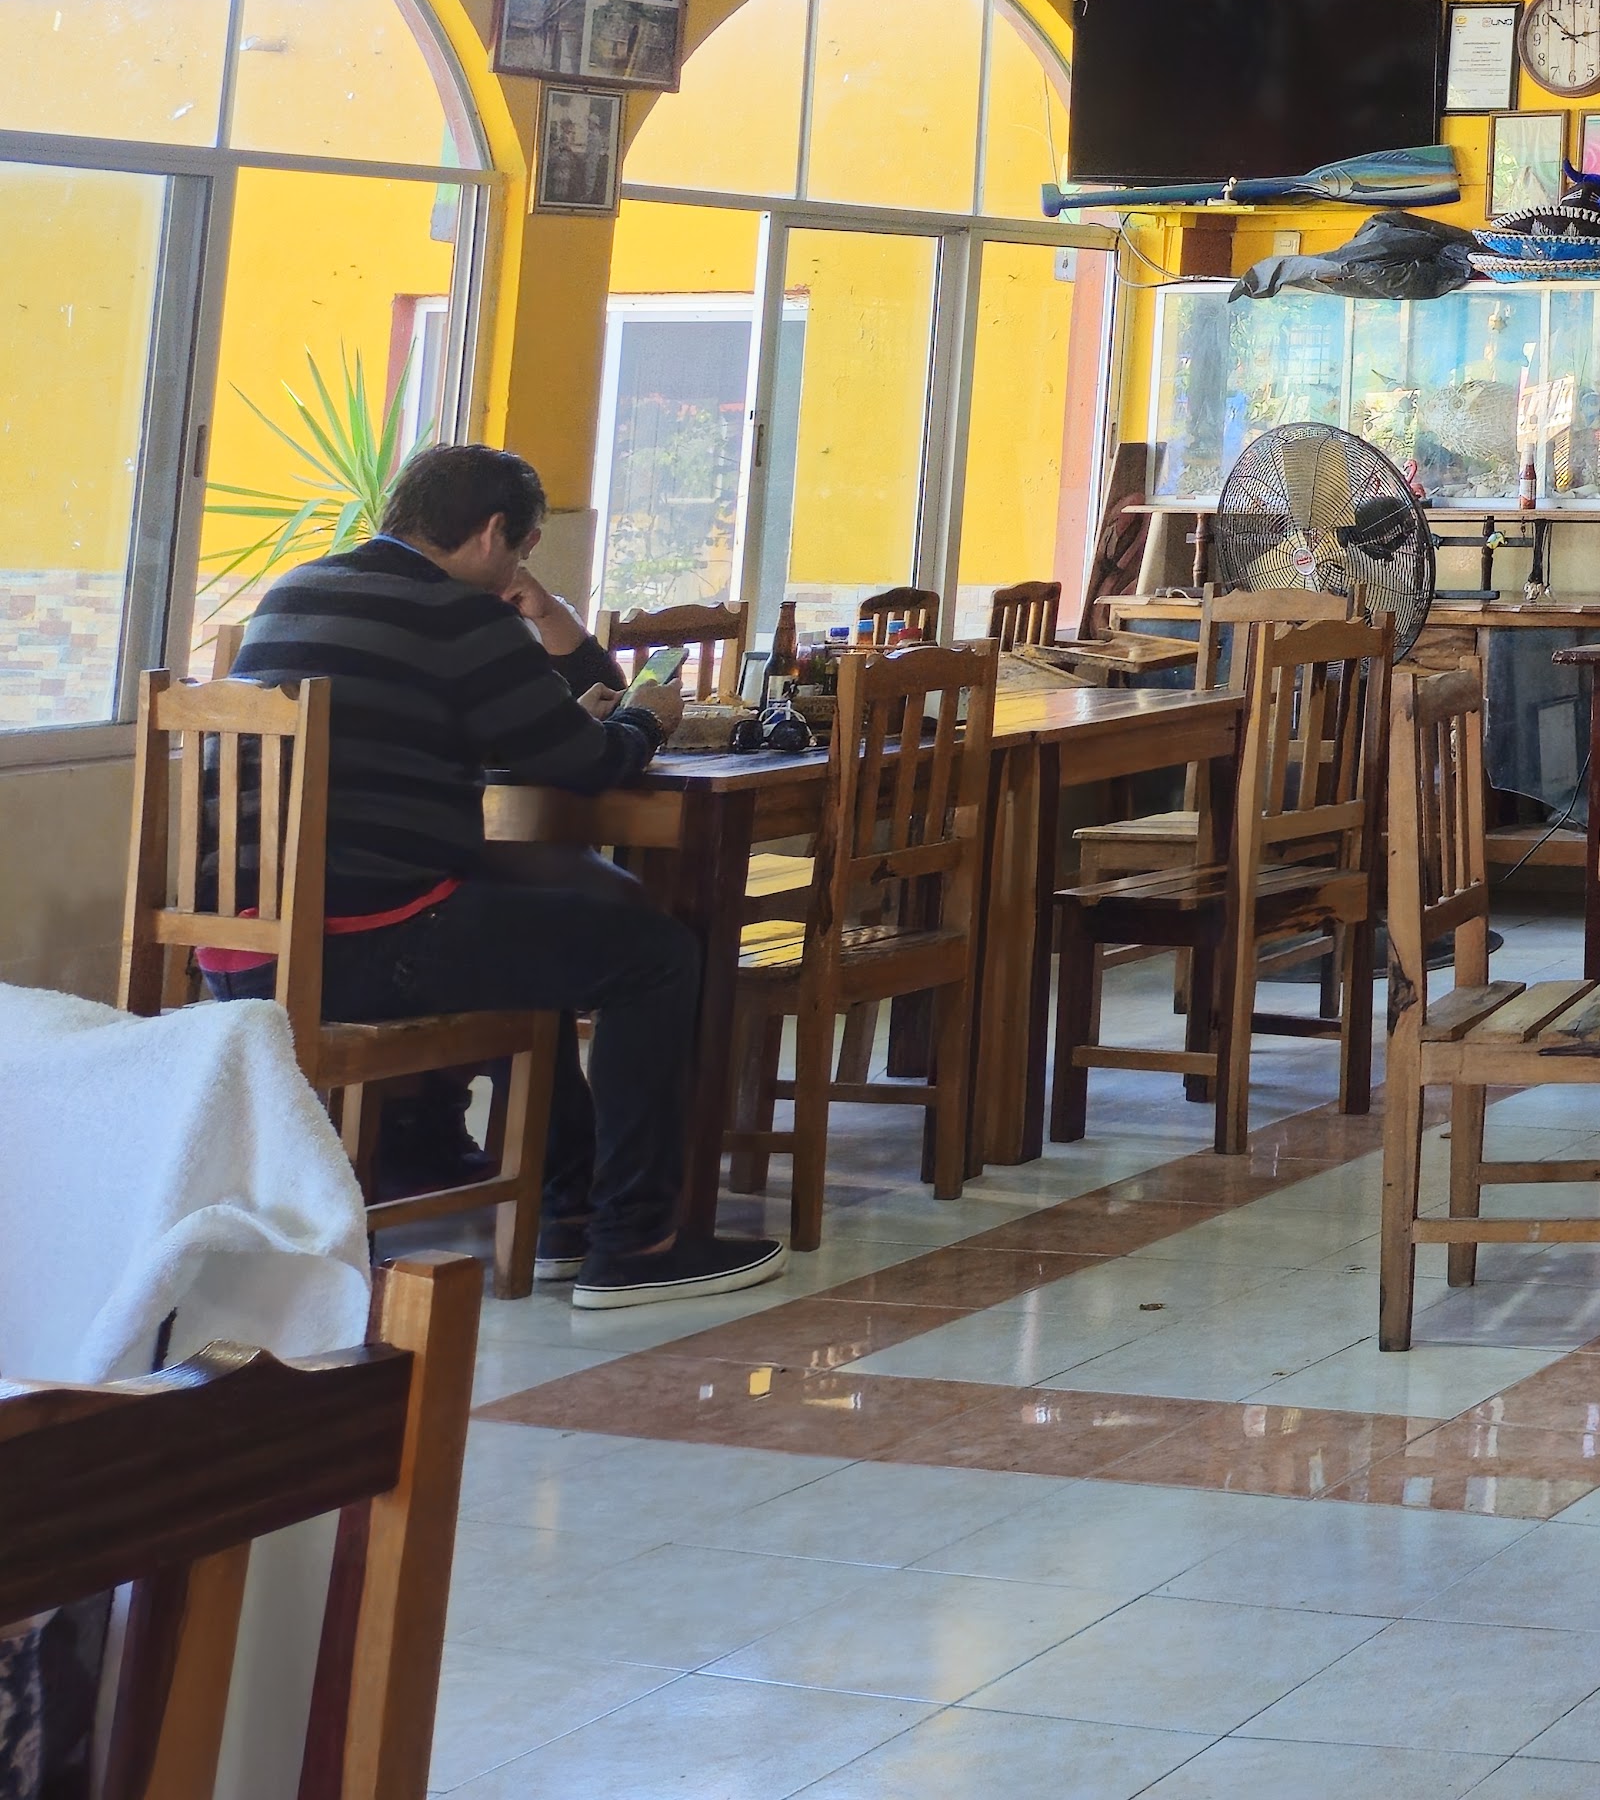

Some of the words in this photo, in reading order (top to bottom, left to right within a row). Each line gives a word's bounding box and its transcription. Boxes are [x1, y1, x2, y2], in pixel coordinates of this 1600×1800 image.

[1533, 13, 1550, 27] 10
[1533, 32, 1541, 46] 9
[1538, 52, 1545, 66] 8
[1550, 66, 1560, 80] 7
[1568, 70, 1577, 84] 6
[1586, 63, 1595, 78] 5
